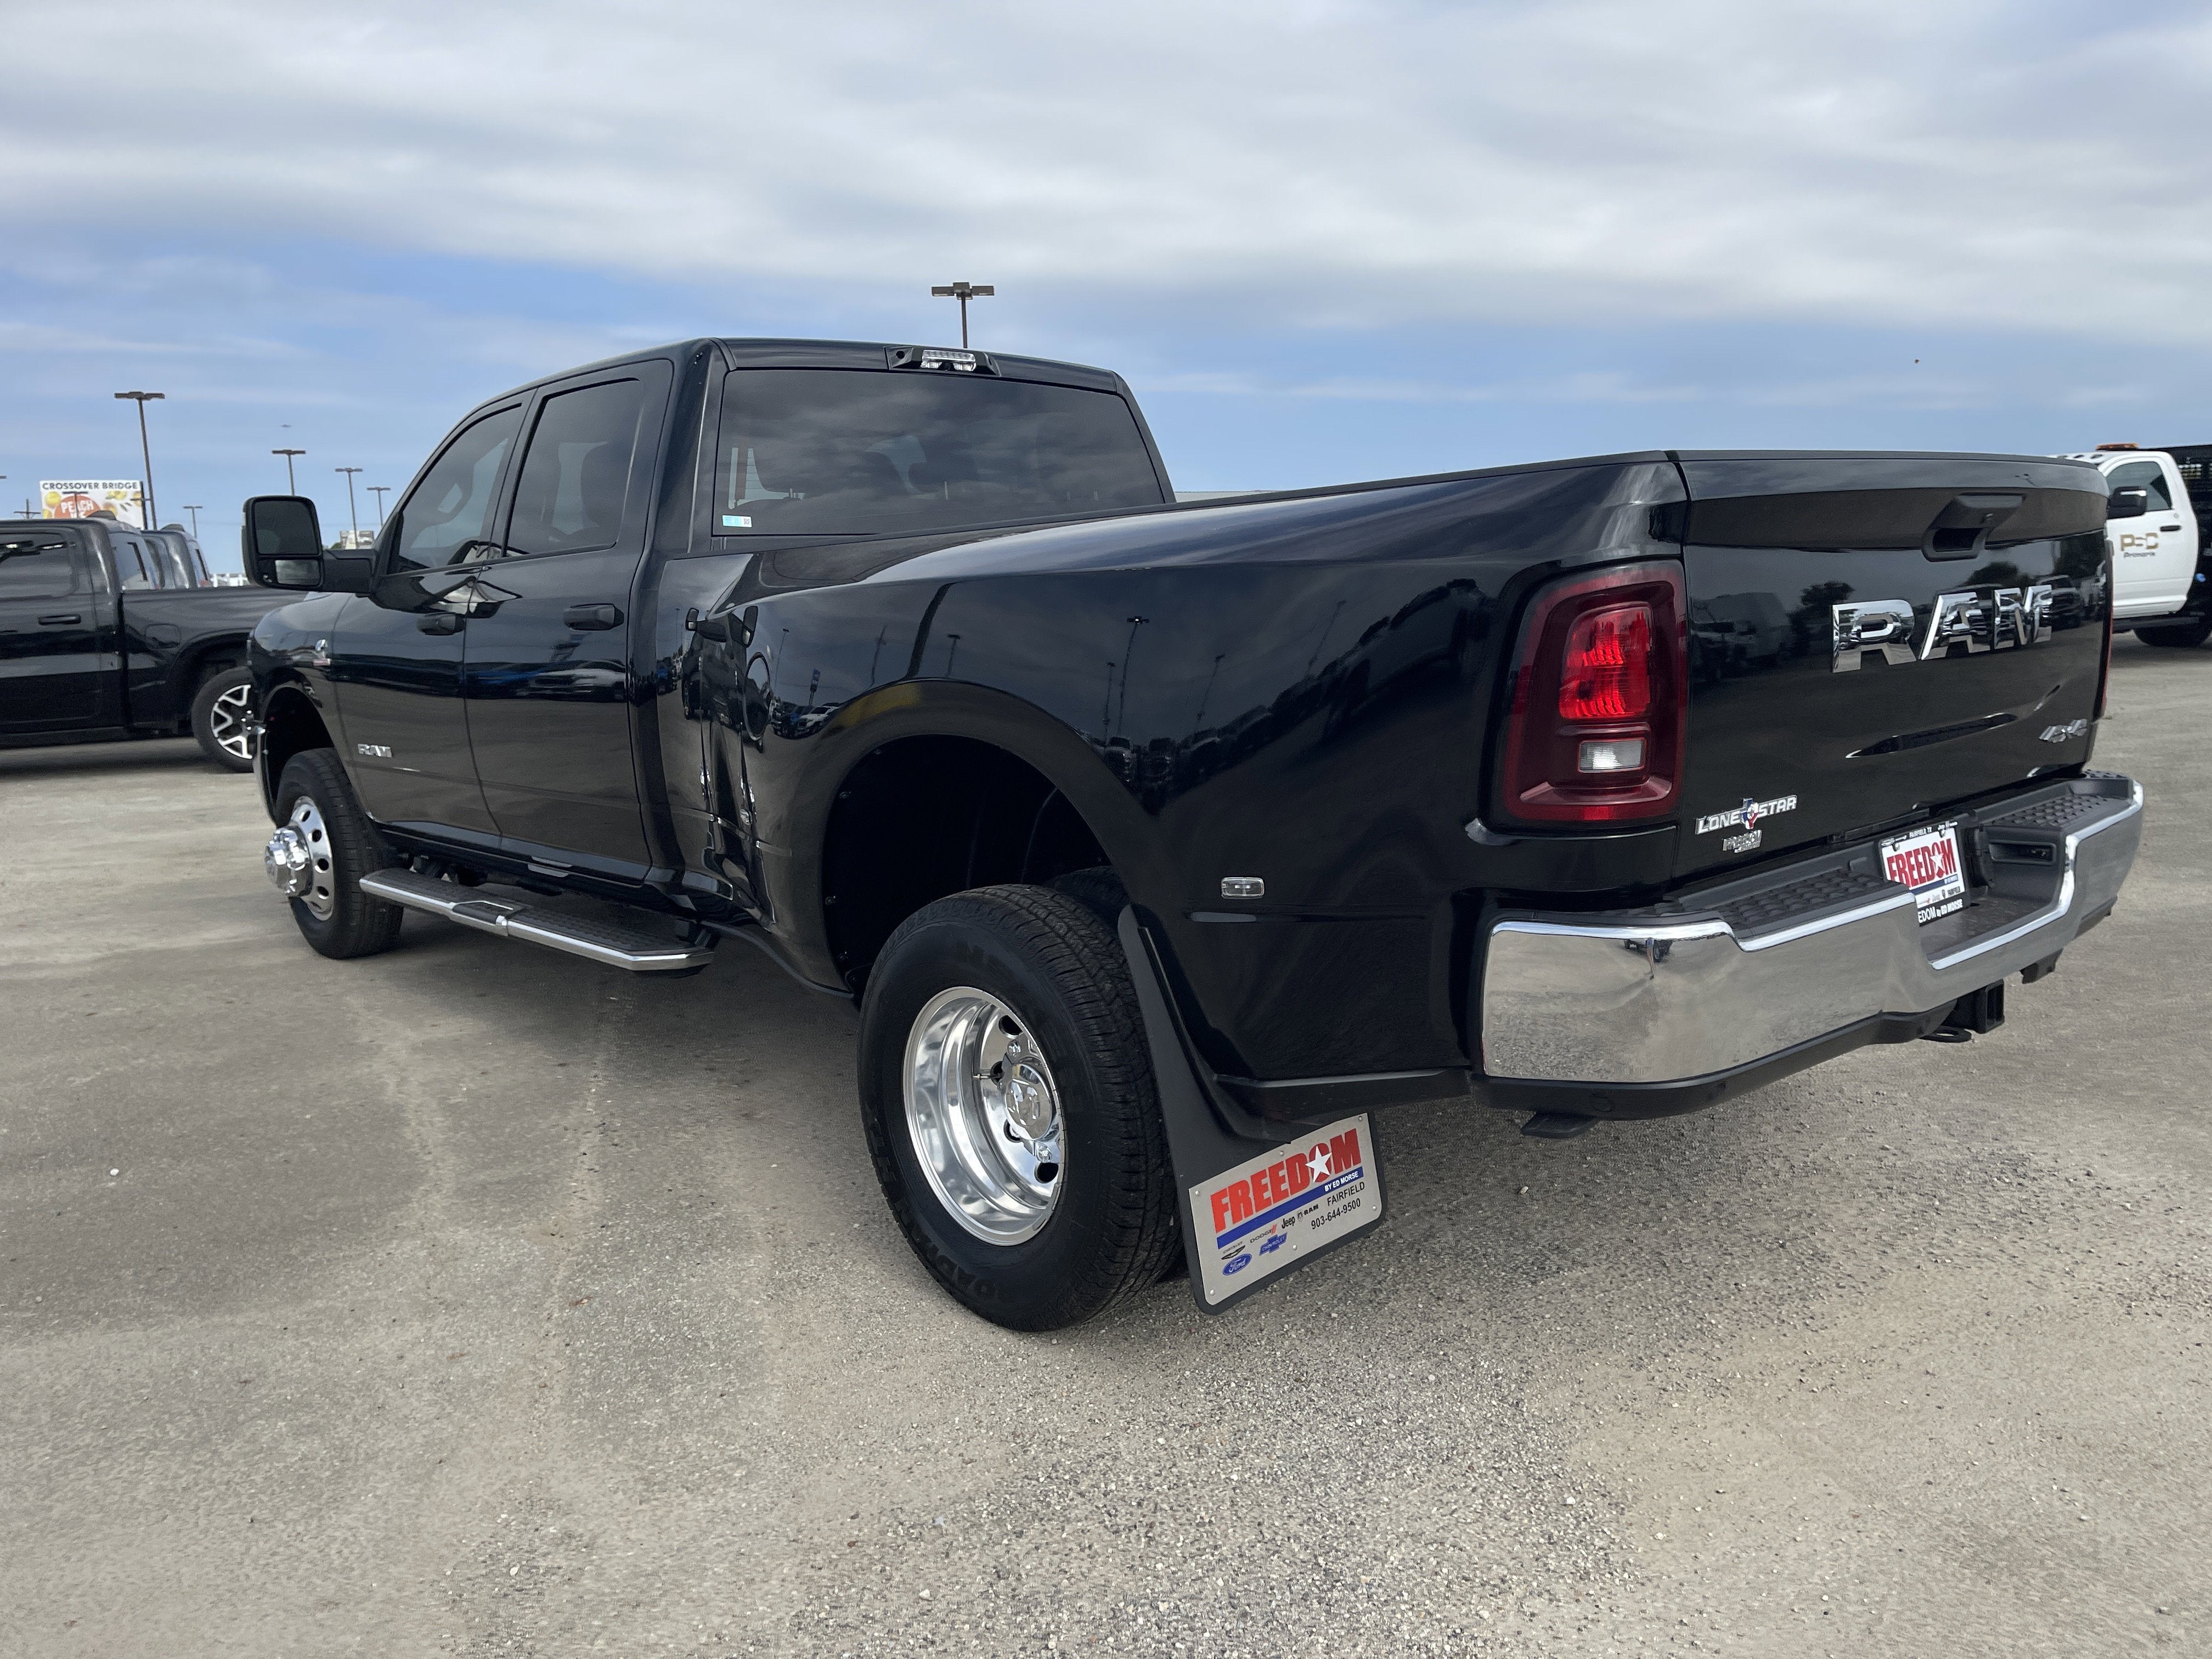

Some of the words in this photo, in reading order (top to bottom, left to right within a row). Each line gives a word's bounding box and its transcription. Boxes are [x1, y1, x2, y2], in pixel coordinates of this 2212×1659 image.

[1832, 584, 2052, 673] RAM
[357, 743, 392, 758] RAM
[1695, 811, 1741, 835] LONE
[1758, 795, 1797, 818] STAR
[1887, 838, 1957, 888] FREEDOM
[1917, 906, 1937, 923] EDOM
[1210, 1128, 1361, 1234] FREEDOM
[1324, 1183, 1332, 1192] BY
[1332, 1180, 1340, 1188] ED
[1340, 1171, 1358, 1184] MORSE
[1327, 1182, 1365, 1206] FAIRFIELD
[1304, 1204, 1319, 1215] RAM
[1311, 1198, 1361, 1229] 903-644-9500
[1282, 1216, 1295, 1229] Jeep
[1250, 1228, 1273, 1243] DODGE
[1229, 1257, 1247, 1273] Ford
